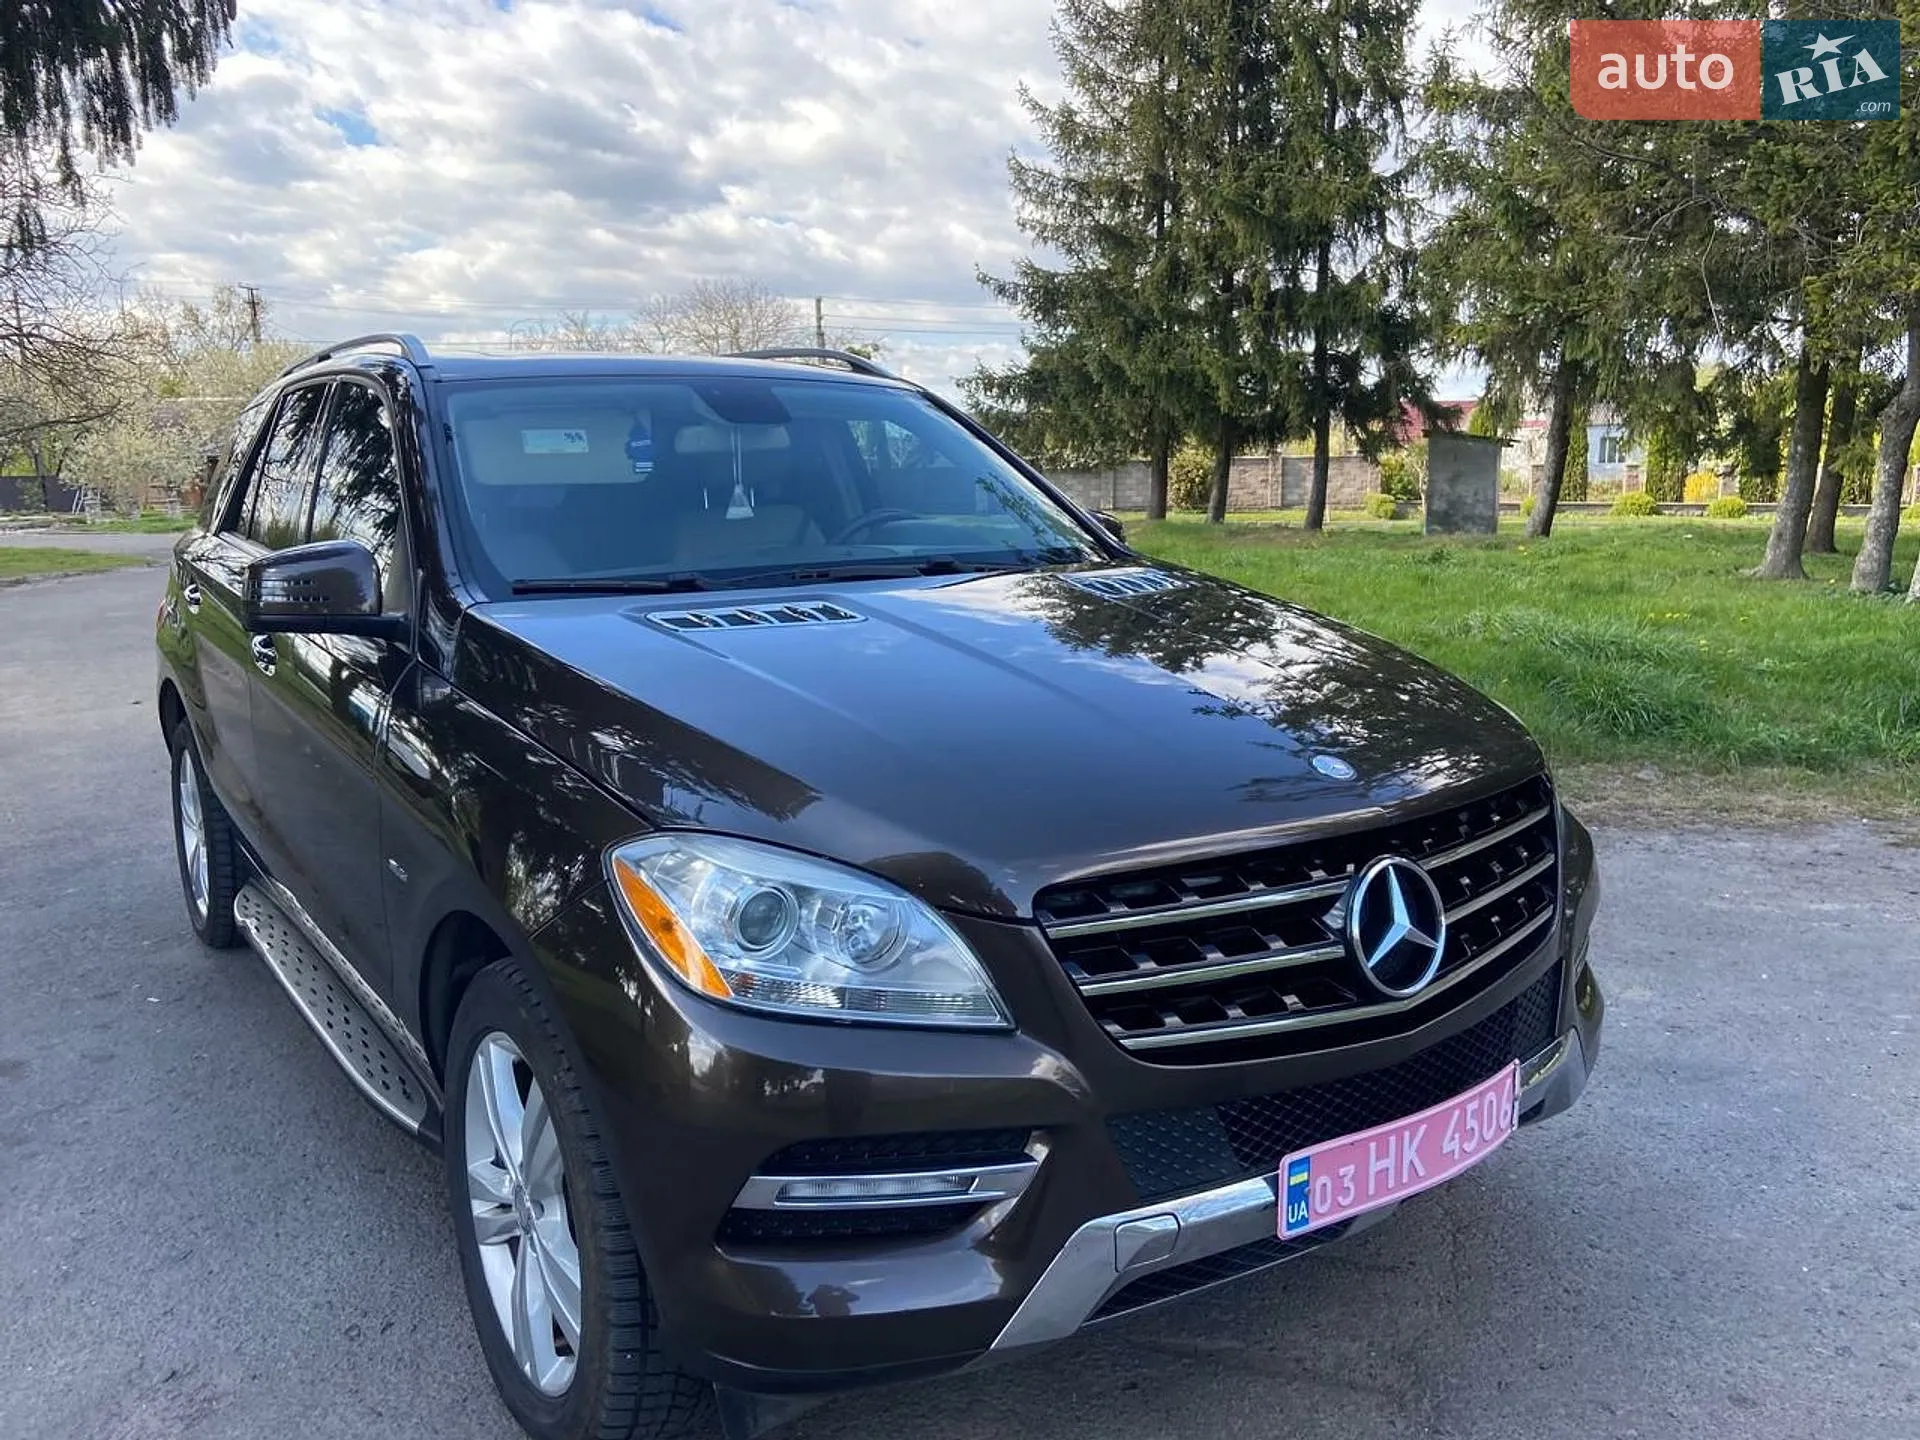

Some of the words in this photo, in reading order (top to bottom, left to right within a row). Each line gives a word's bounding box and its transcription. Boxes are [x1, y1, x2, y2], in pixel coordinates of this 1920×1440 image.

[1314, 1164, 1355, 1214] 03
[1368, 1123, 1427, 1196] HK
[1442, 1078, 1512, 1161] 4506
[1287, 1201, 1308, 1223] UA
